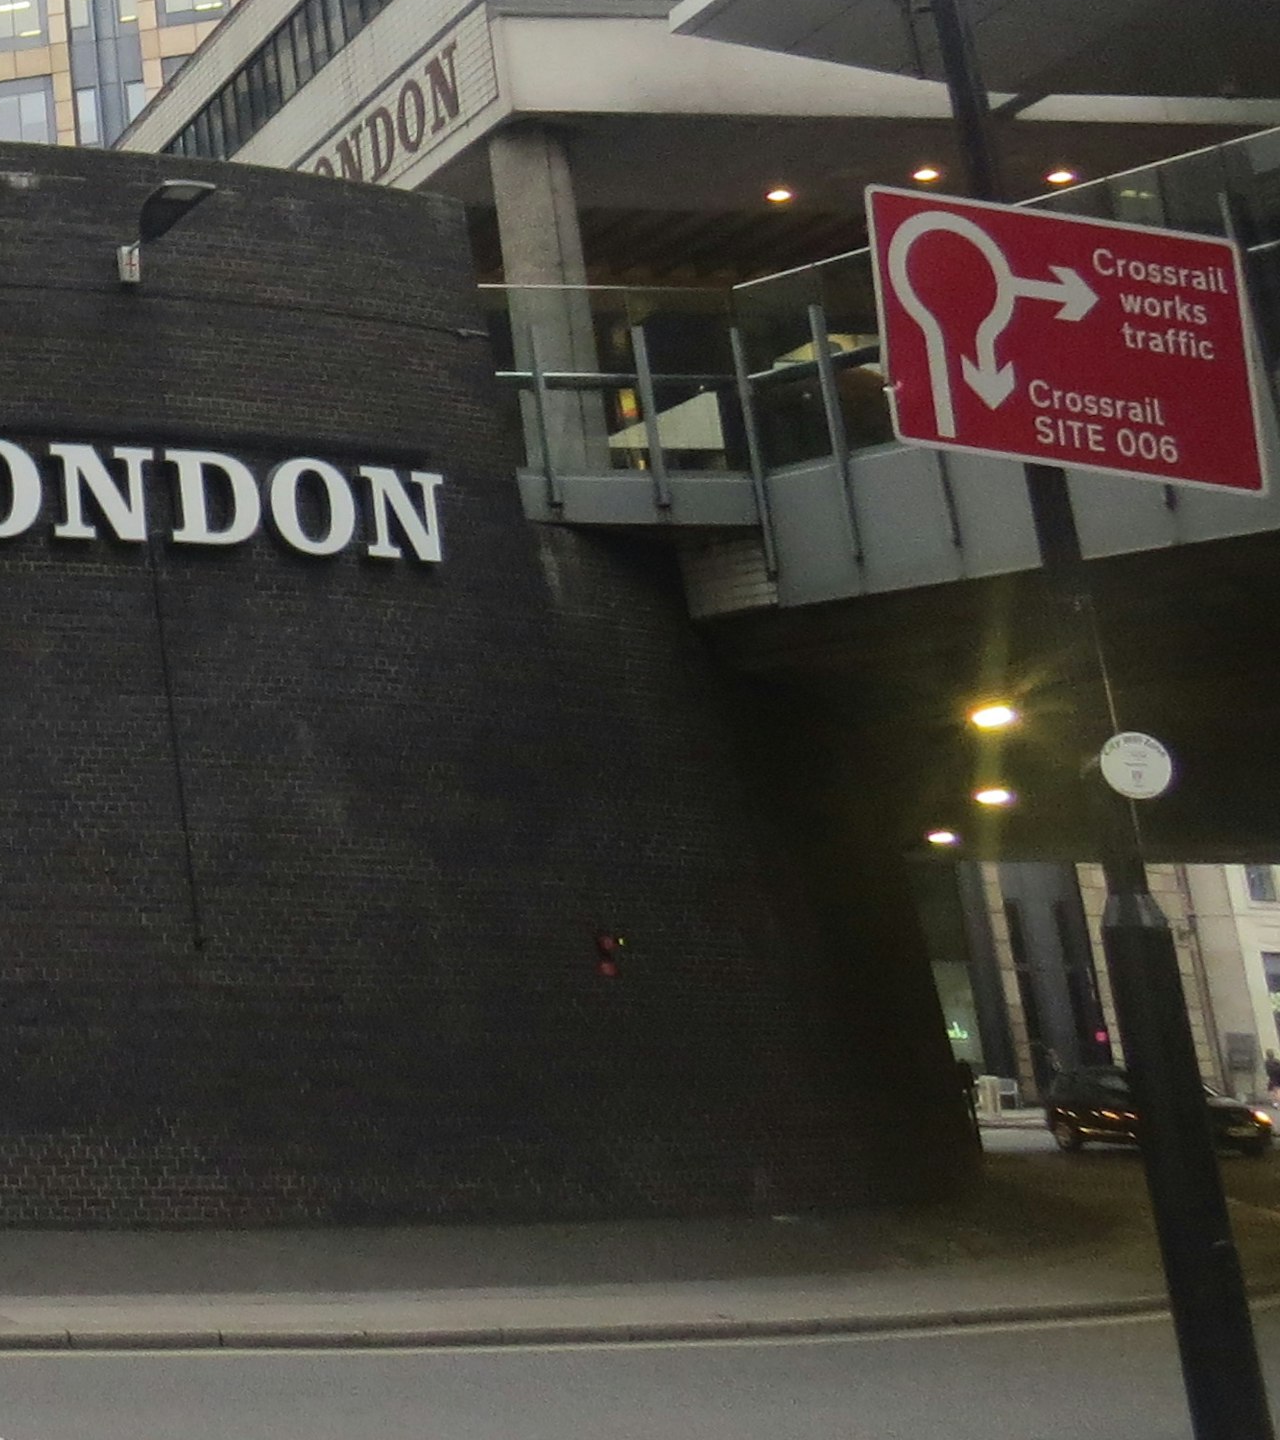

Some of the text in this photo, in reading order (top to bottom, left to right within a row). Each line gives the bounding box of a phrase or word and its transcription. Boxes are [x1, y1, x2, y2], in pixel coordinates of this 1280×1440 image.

[1092, 248, 1229, 295] Crossrail
[1120, 292, 1208, 325] works
[1121, 320, 1215, 360] traffic
[1028, 379, 1165, 427] Crossrail
[1034, 416, 1179, 464] SITE 006
